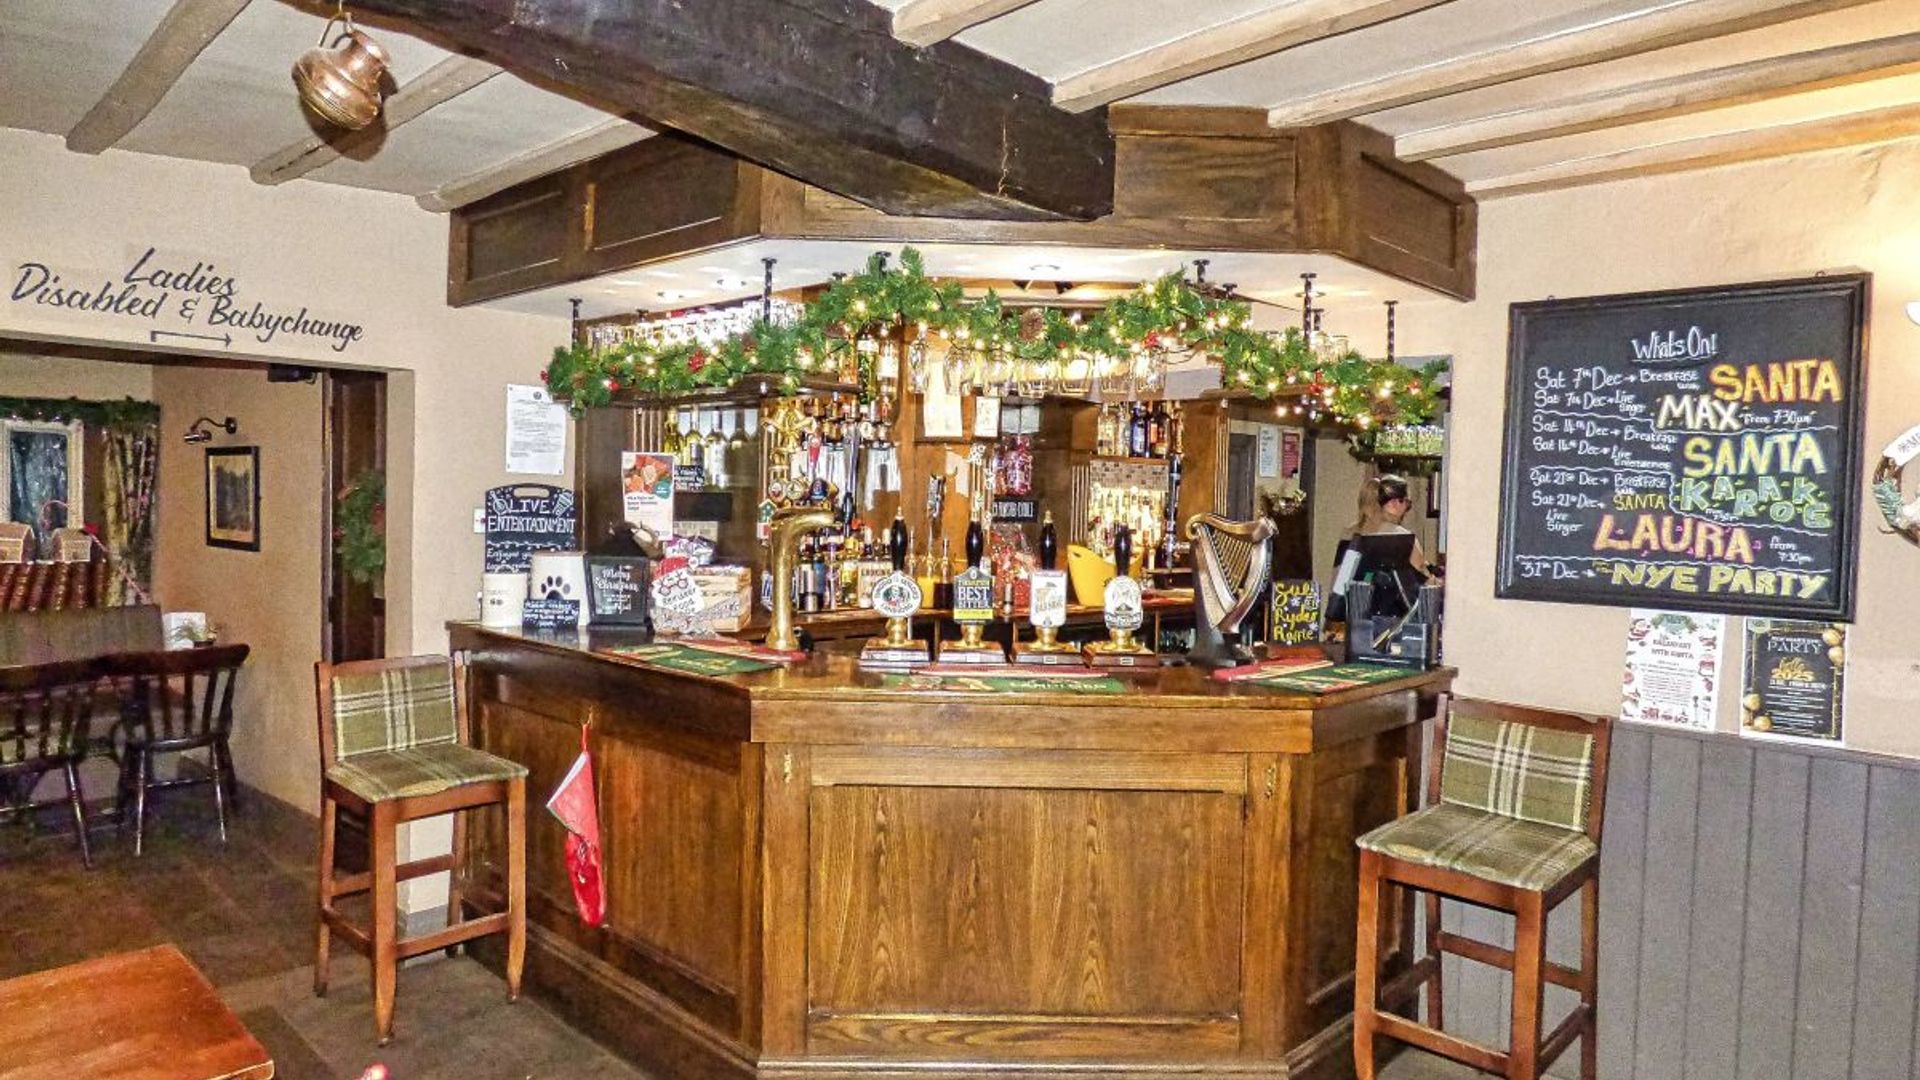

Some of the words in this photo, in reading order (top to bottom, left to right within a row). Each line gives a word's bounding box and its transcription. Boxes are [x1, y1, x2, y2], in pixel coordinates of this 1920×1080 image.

[123, 247, 239, 297] Ladies
[11, 262, 165, 320] Disabled
[178, 298, 200, 324] &
[207, 296, 363, 352] Babychange
[1534, 366, 1566, 390] Sat
[1592, 365, 1623, 391] Dec
[1639, 368, 1699, 383] Breakfast
[1709, 359, 1844, 403] SANTA
[1534, 389, 1560, 408] Sat
[1583, 391, 1607, 410] Dec
[1615, 389, 1635, 404] Live
[1656, 394, 1743, 431] MAX
[1532, 414, 1560, 433] Sat
[1585, 421, 1609, 438] Dec
[1683, 432, 1828, 478] SANTA
[1532, 436, 1555, 452] Sat
[1578, 440, 1600, 455] Dec
[1611, 444, 1632, 460] Live
[1529, 470, 1551, 487] Sat
[1578, 471, 1600, 486] Dec
[1613, 493, 1666, 511] SANTA
[1532, 490, 1555, 507] Sat
[1576, 493, 1599, 509] Dec
[509, 499, 551, 514] LIVE
[1545, 508, 1569, 523] Live
[487, 515, 576, 534] ENTERTAINMENT
[1546, 520, 1585, 536] Singer
[1593, 513, 1755, 564] LAURA
[1552, 560, 1580, 580] Dec
[1611, 561, 1699, 593] NYE
[1708, 564, 1829, 600] PARTY
[957, 586, 991, 601] BEST
[1274, 605, 1319, 630] Ryder
[1273, 625, 1314, 643] Raffle
[1767, 640, 1823, 654] PARTY
